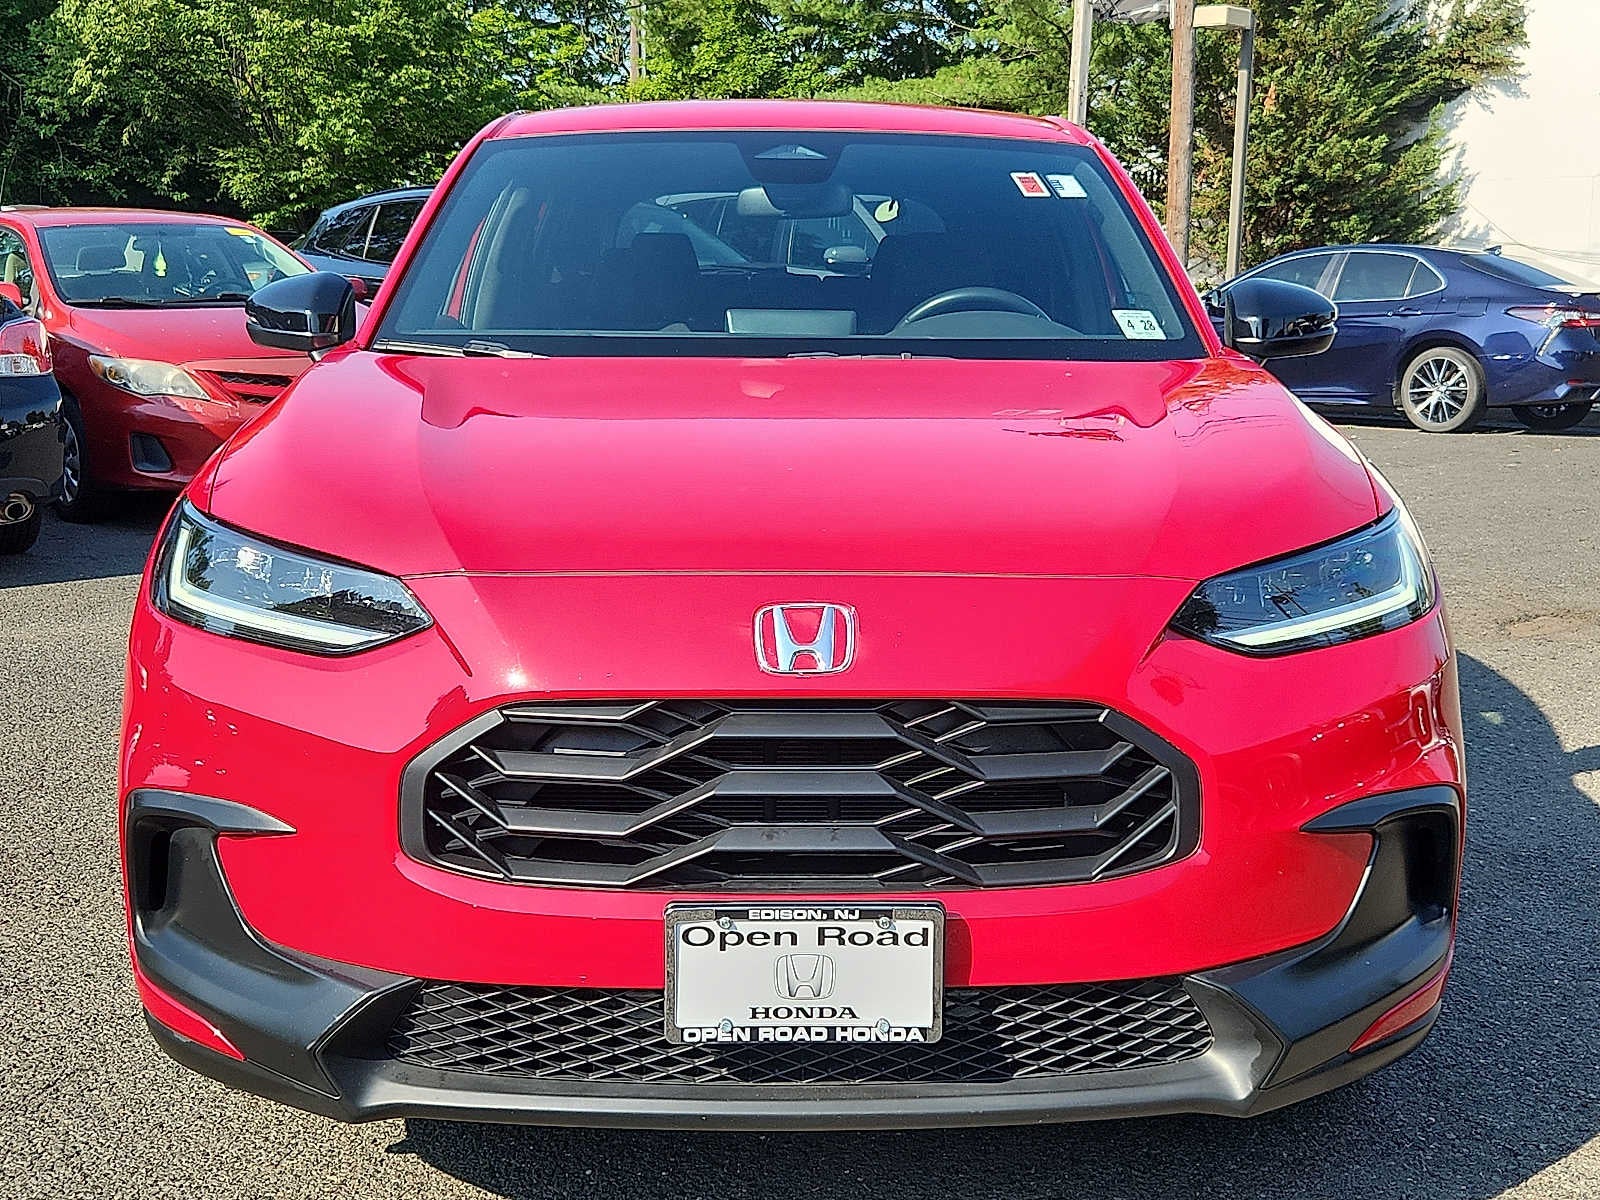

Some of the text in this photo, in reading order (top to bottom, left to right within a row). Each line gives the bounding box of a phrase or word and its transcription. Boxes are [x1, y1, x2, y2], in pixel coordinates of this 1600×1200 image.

[1127, 320, 1156, 331] 4 28
[748, 909, 860, 920] EDISON, NJ
[682, 926, 929, 951] Open Road
[749, 1006, 860, 1019] HONDA
[683, 1027, 925, 1042] OPEN ROAD HONDA
